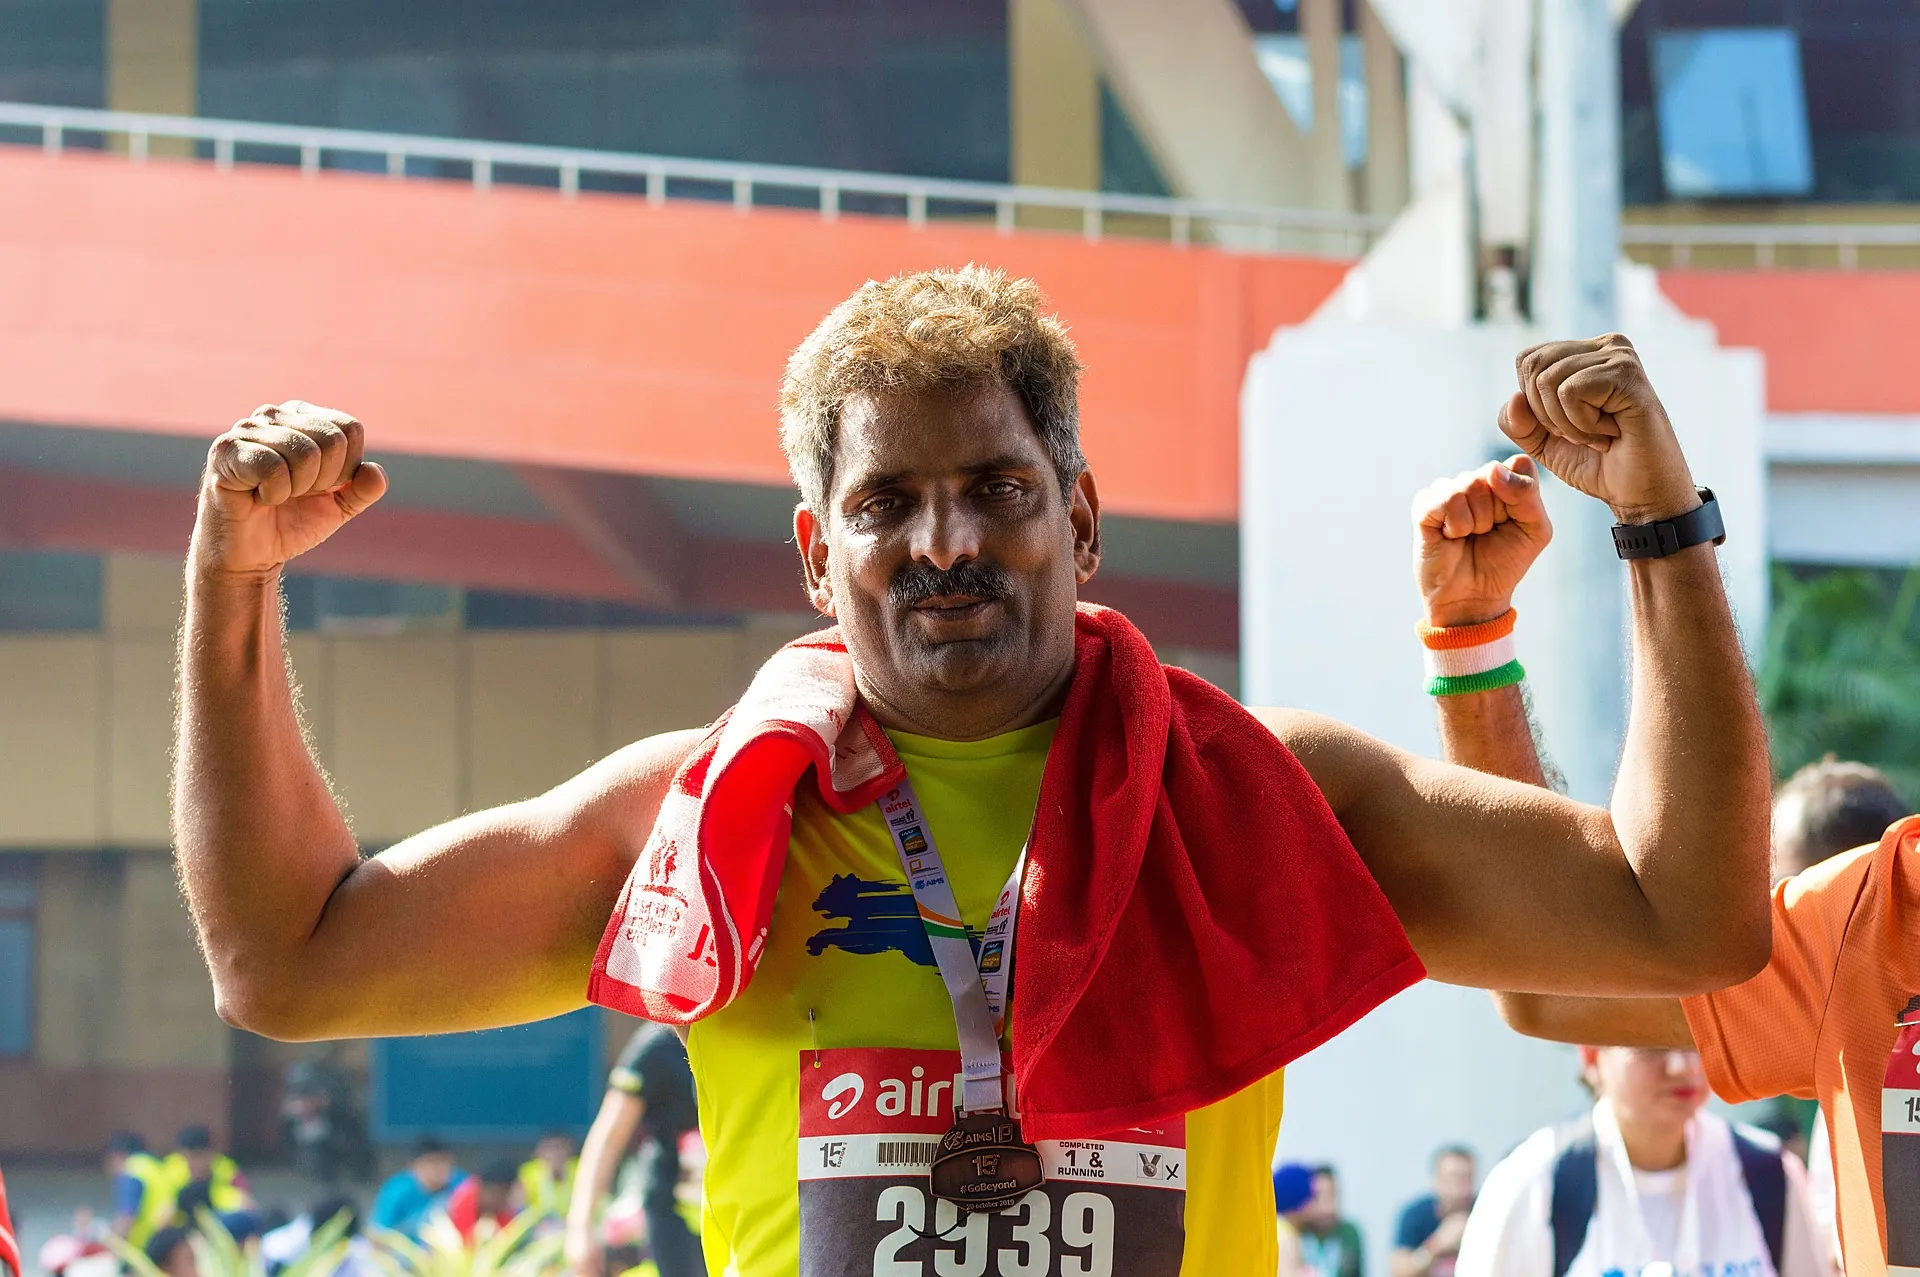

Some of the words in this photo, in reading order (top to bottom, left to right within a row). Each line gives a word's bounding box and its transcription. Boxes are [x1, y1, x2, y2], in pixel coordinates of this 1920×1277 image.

[885, 798, 913, 813] airtel
[926, 878, 944, 887] AIMS
[991, 905, 1011, 919] airtel
[988, 1005, 1000, 1013] MS
[965, 1132, 993, 1144] AIMS
[1059, 1141, 1105, 1151] COMPLETED
[820, 1142, 843, 1168] 15
[1065, 1150, 1076, 1166] 1
[1089, 1152, 1103, 1168] &
[972, 1154, 994, 1176] 15
[1057, 1167, 1104, 1178] RUNNING
[960, 1180, 1017, 1194] #GoBeyond
[975, 1201, 999, 1209] october
[873, 1186, 1115, 1277] 2939
